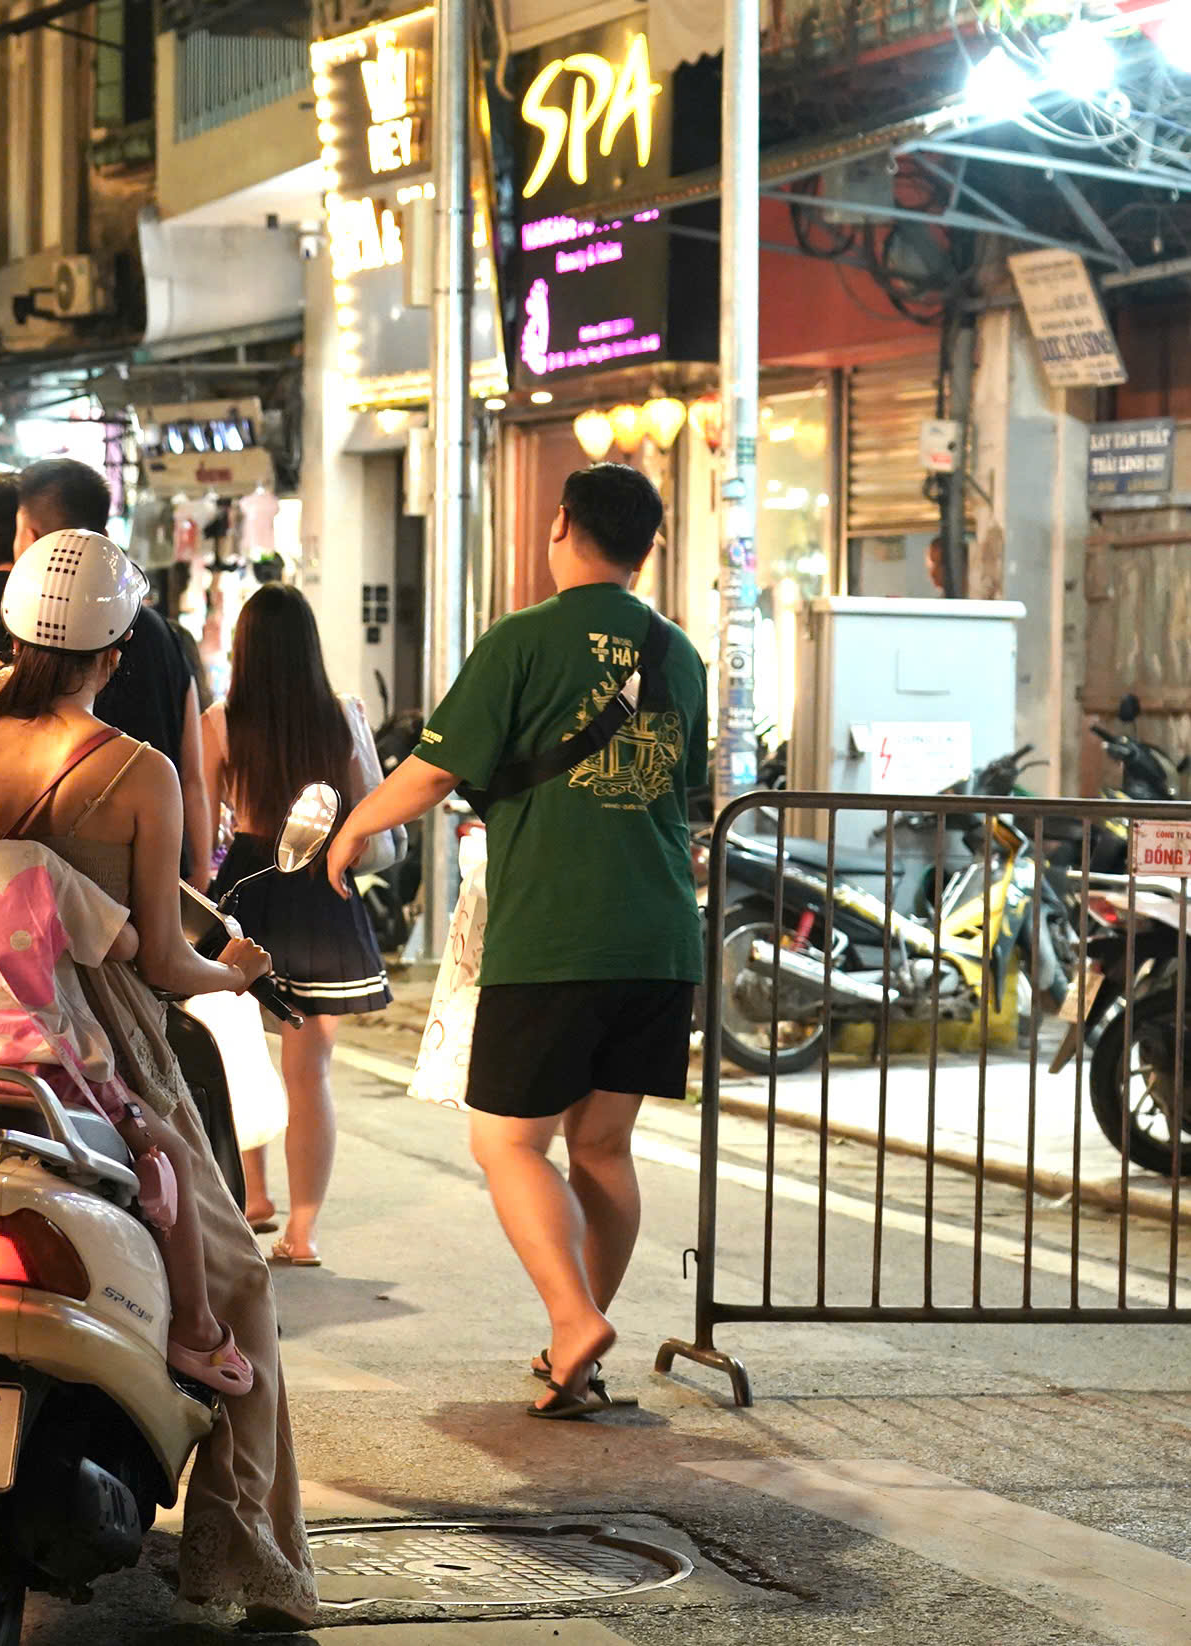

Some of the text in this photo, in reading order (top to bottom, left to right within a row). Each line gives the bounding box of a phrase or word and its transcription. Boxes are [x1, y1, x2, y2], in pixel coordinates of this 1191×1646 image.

[521, 31, 662, 198] SPA
[588, 632, 608, 662] 7
[102, 1286, 146, 1319] SPACY
